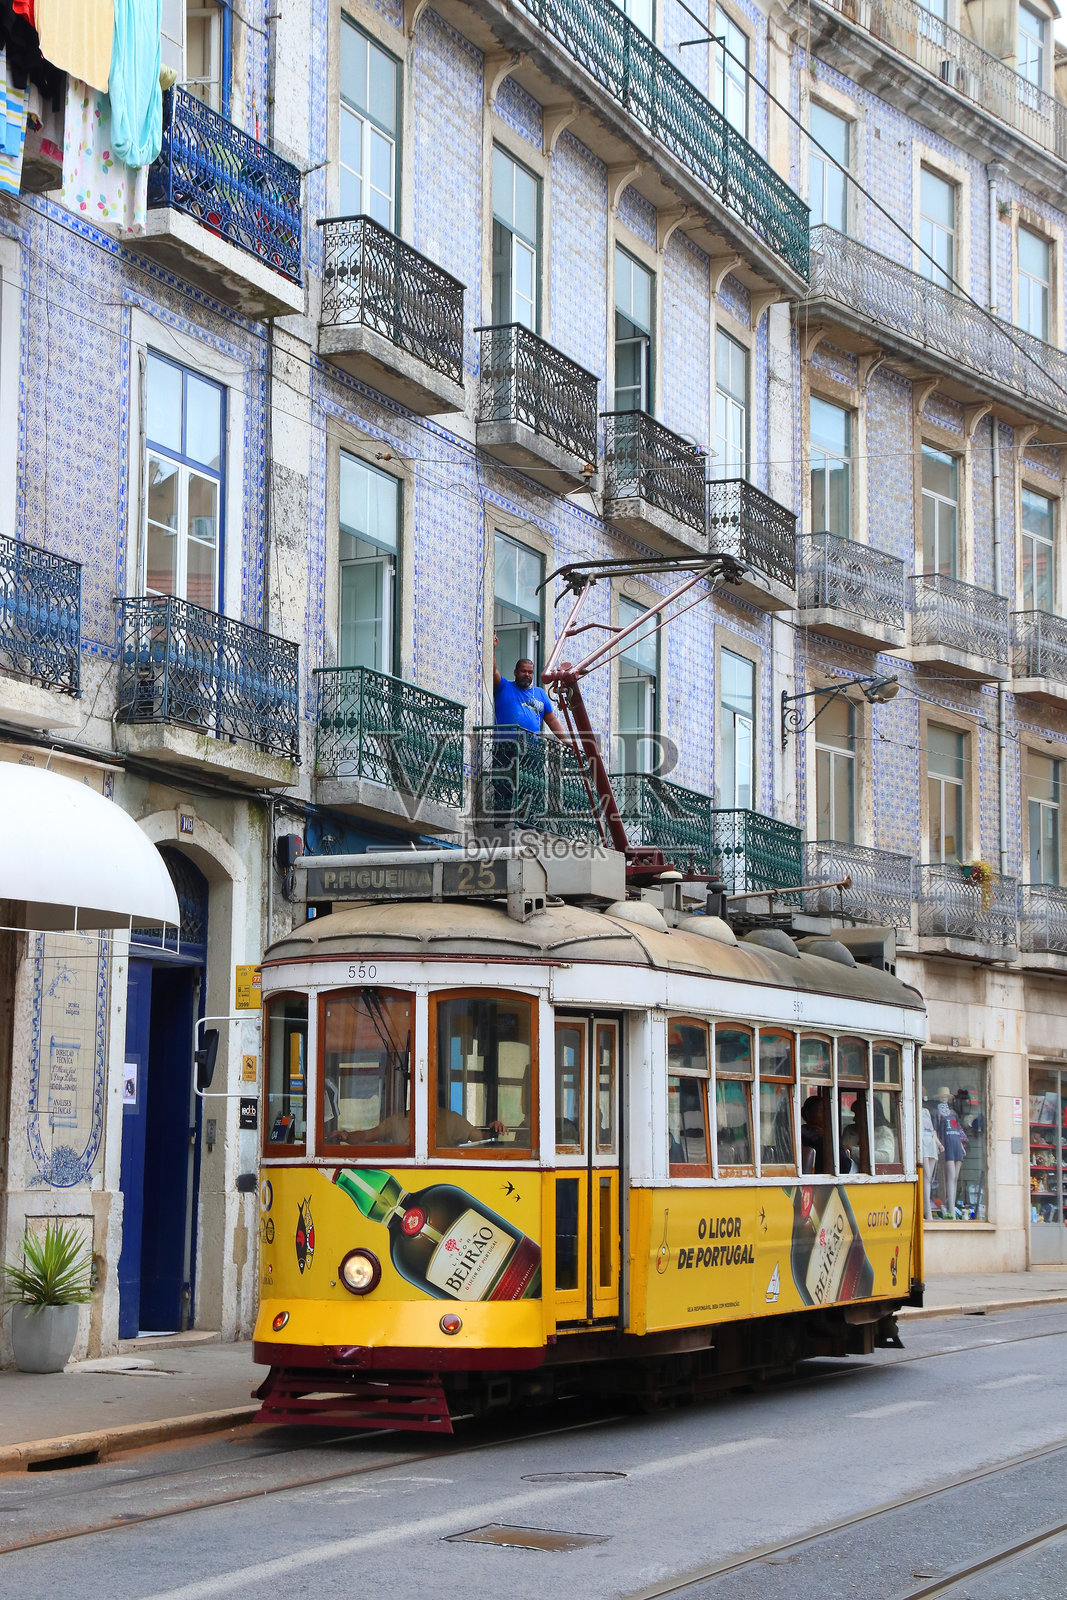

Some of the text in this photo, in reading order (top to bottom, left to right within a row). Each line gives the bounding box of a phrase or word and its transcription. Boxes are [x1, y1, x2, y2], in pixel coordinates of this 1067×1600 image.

[324, 869, 433, 889] P.FIGUEIRA
[457, 863, 496, 890] 25
[348, 964, 377, 979] 550
[698, 1217, 742, 1240] O LICOR
[867, 1205, 889, 1228] carris
[445, 1227, 494, 1292] BEIRÃO
[452, 1238, 471, 1266] LICOR
[481, 1240, 498, 1264] PORTUGAL
[678, 1244, 754, 1269] DE PORTUGAL
